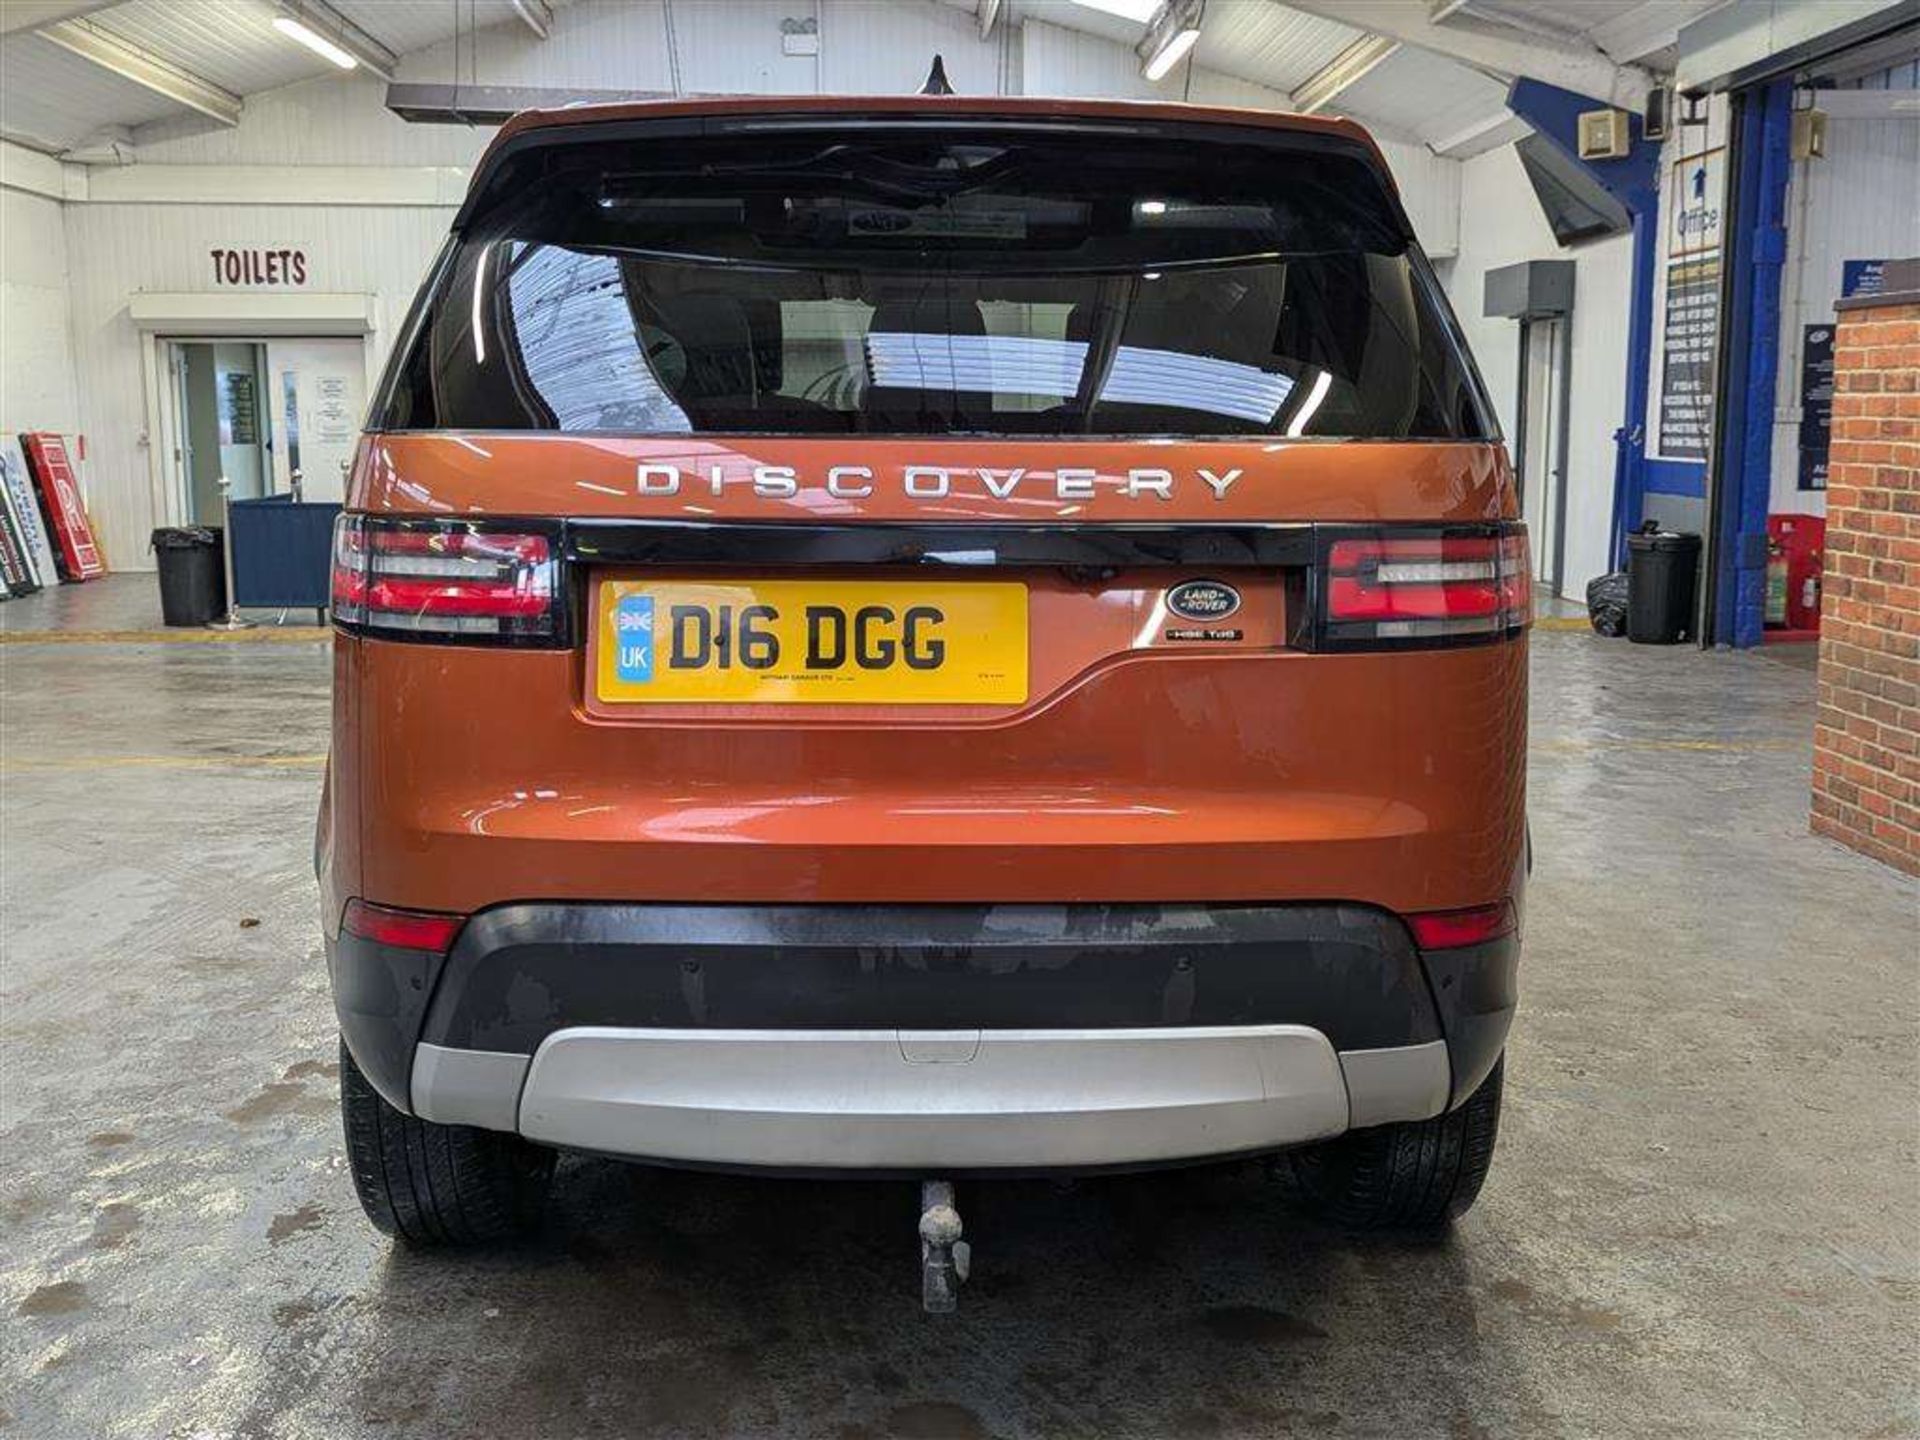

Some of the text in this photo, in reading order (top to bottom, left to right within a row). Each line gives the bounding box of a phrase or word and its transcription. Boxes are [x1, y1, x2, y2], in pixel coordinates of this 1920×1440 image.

[210, 249, 306, 285] TOILETS
[636, 463, 1244, 500] DISCOVERY
[668, 604, 946, 670] D16 DGG
[620, 647, 648, 669] UK
